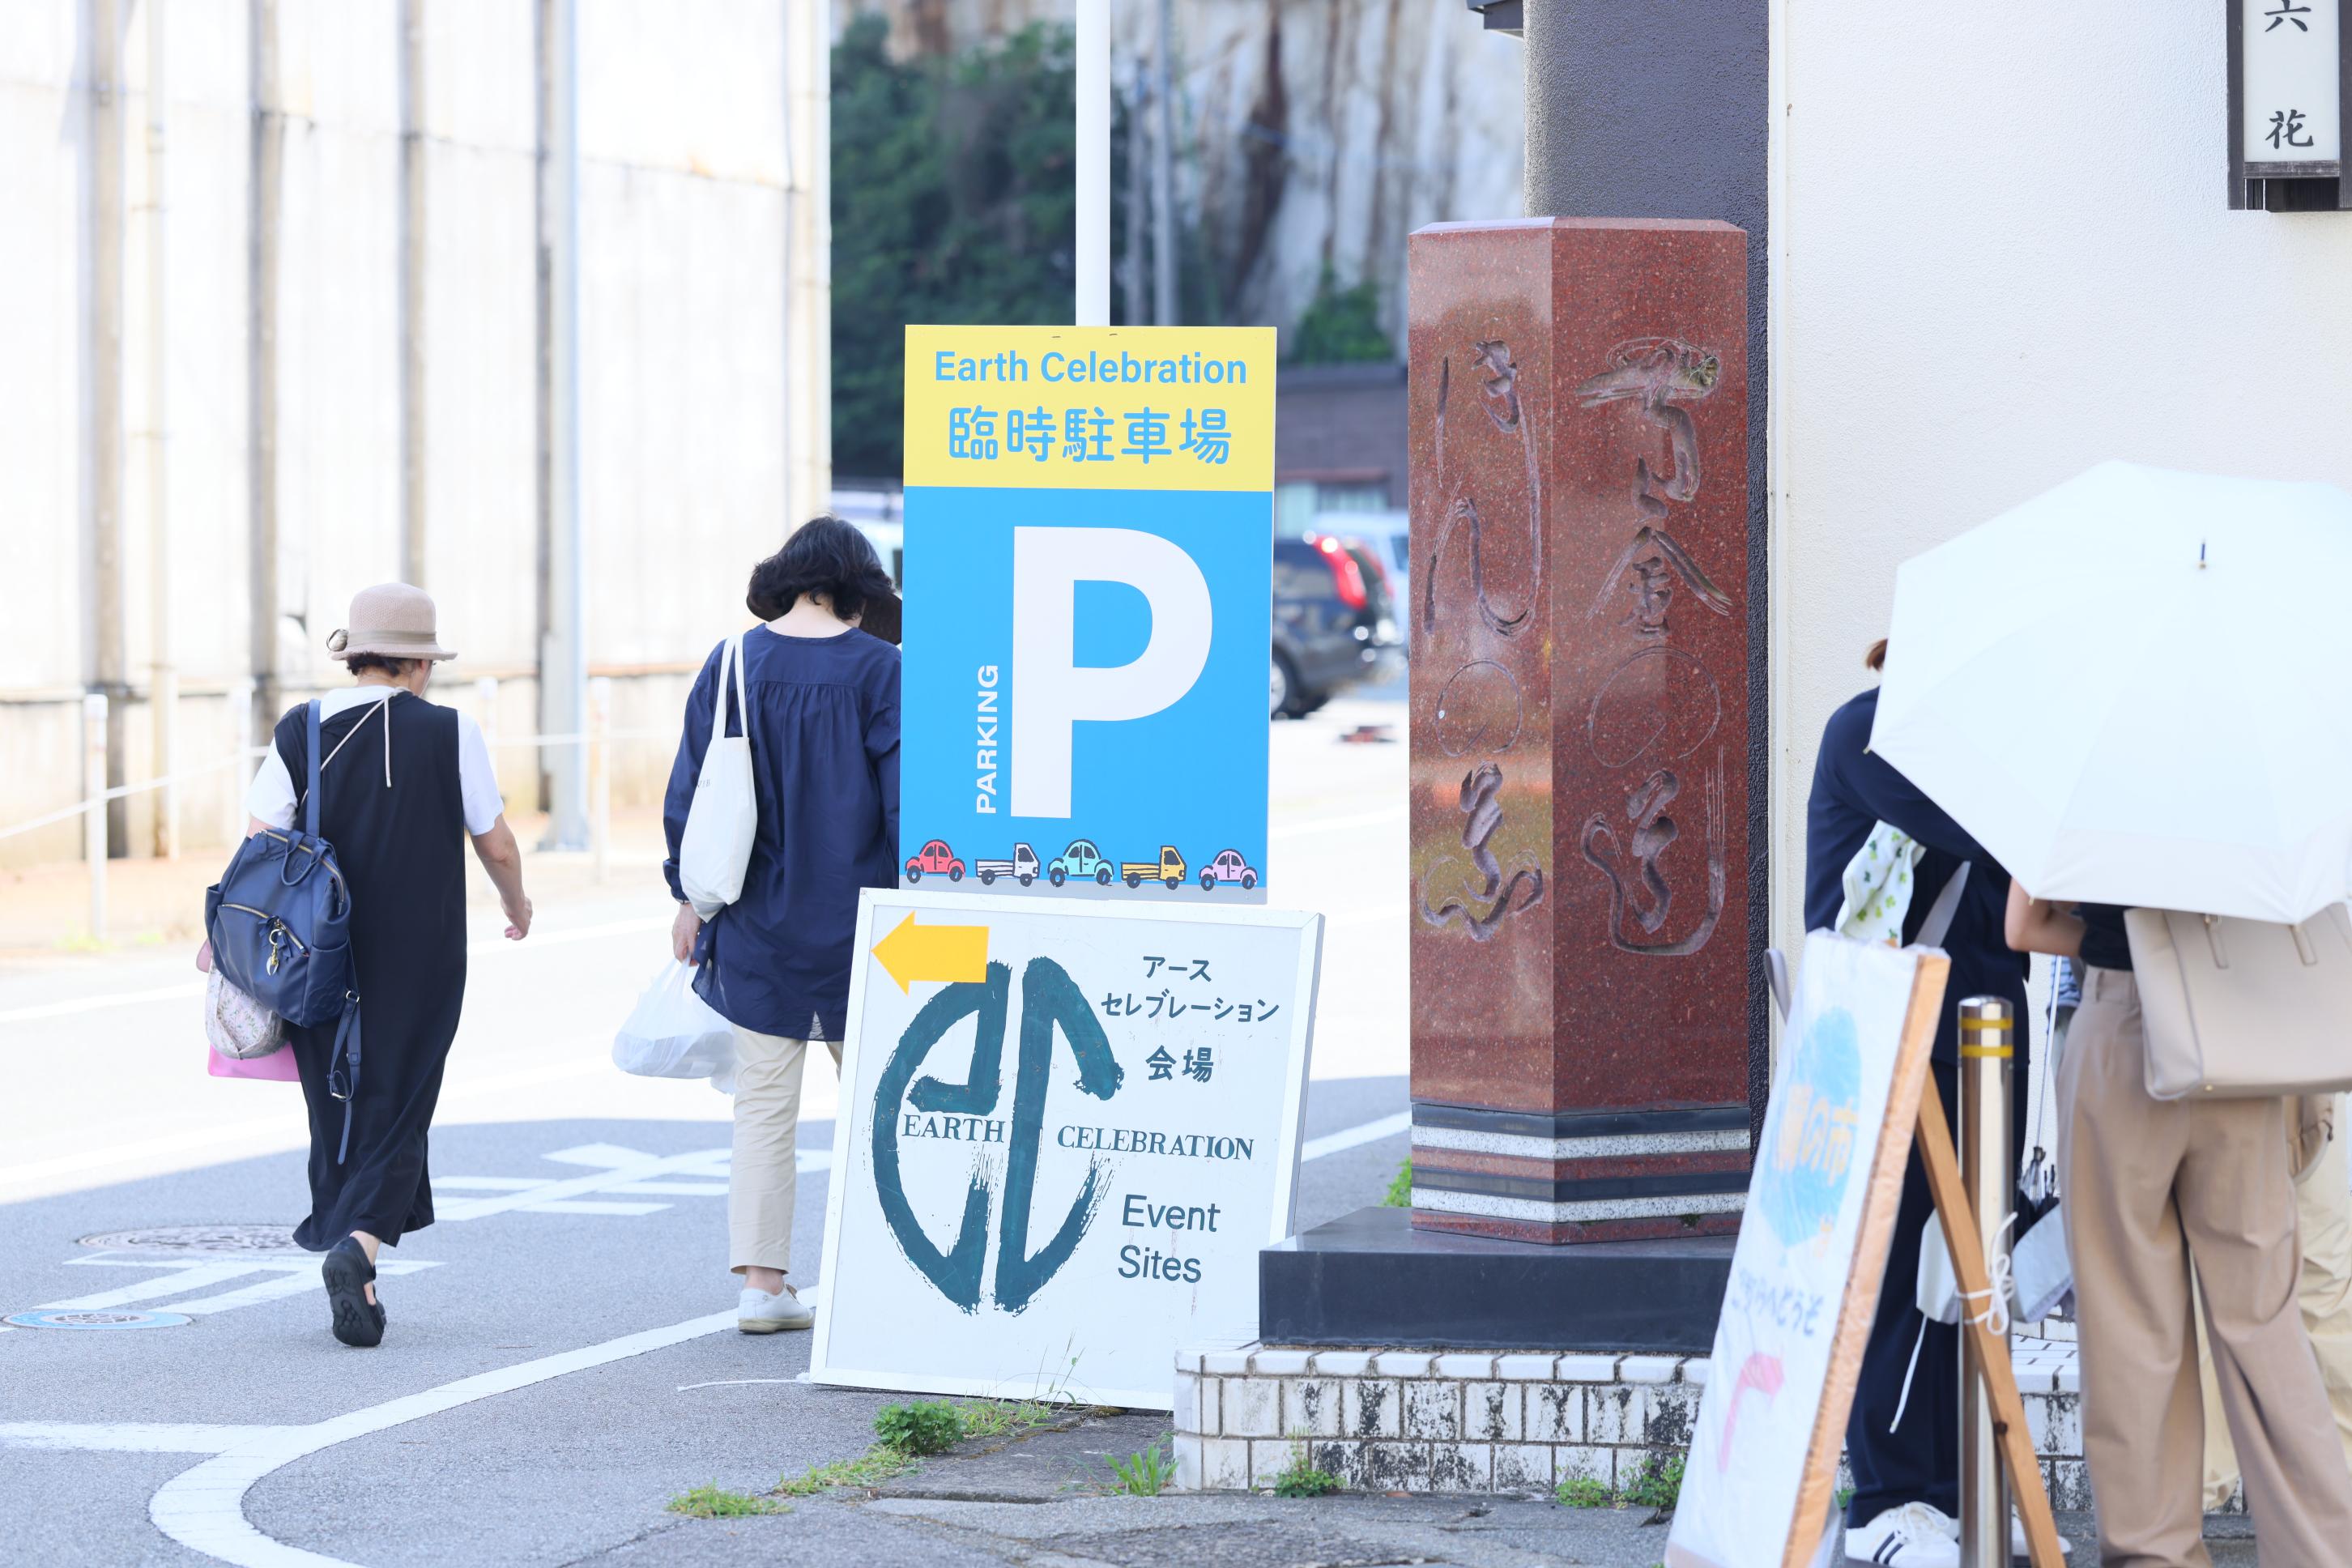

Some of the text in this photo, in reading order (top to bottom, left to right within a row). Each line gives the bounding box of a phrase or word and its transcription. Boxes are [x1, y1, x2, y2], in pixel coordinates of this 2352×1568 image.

[2265, 0, 2314, 149] 六花
[935, 350, 1246, 384] Earth Celebration
[948, 404, 1232, 465] 臨時駐車場
[1010, 526, 1213, 819] P
[976, 664, 999, 814] PARKING
[1143, 956, 1212, 982] アース
[1101, 988, 1280, 1023] セレブレーション
[1145, 1045, 1214, 1084] 会場
[902, 1114, 1255, 1161] EARTH CELEBRATION
[1122, 1194, 1221, 1233] Event
[1118, 1244, 1202, 1284] Sites
